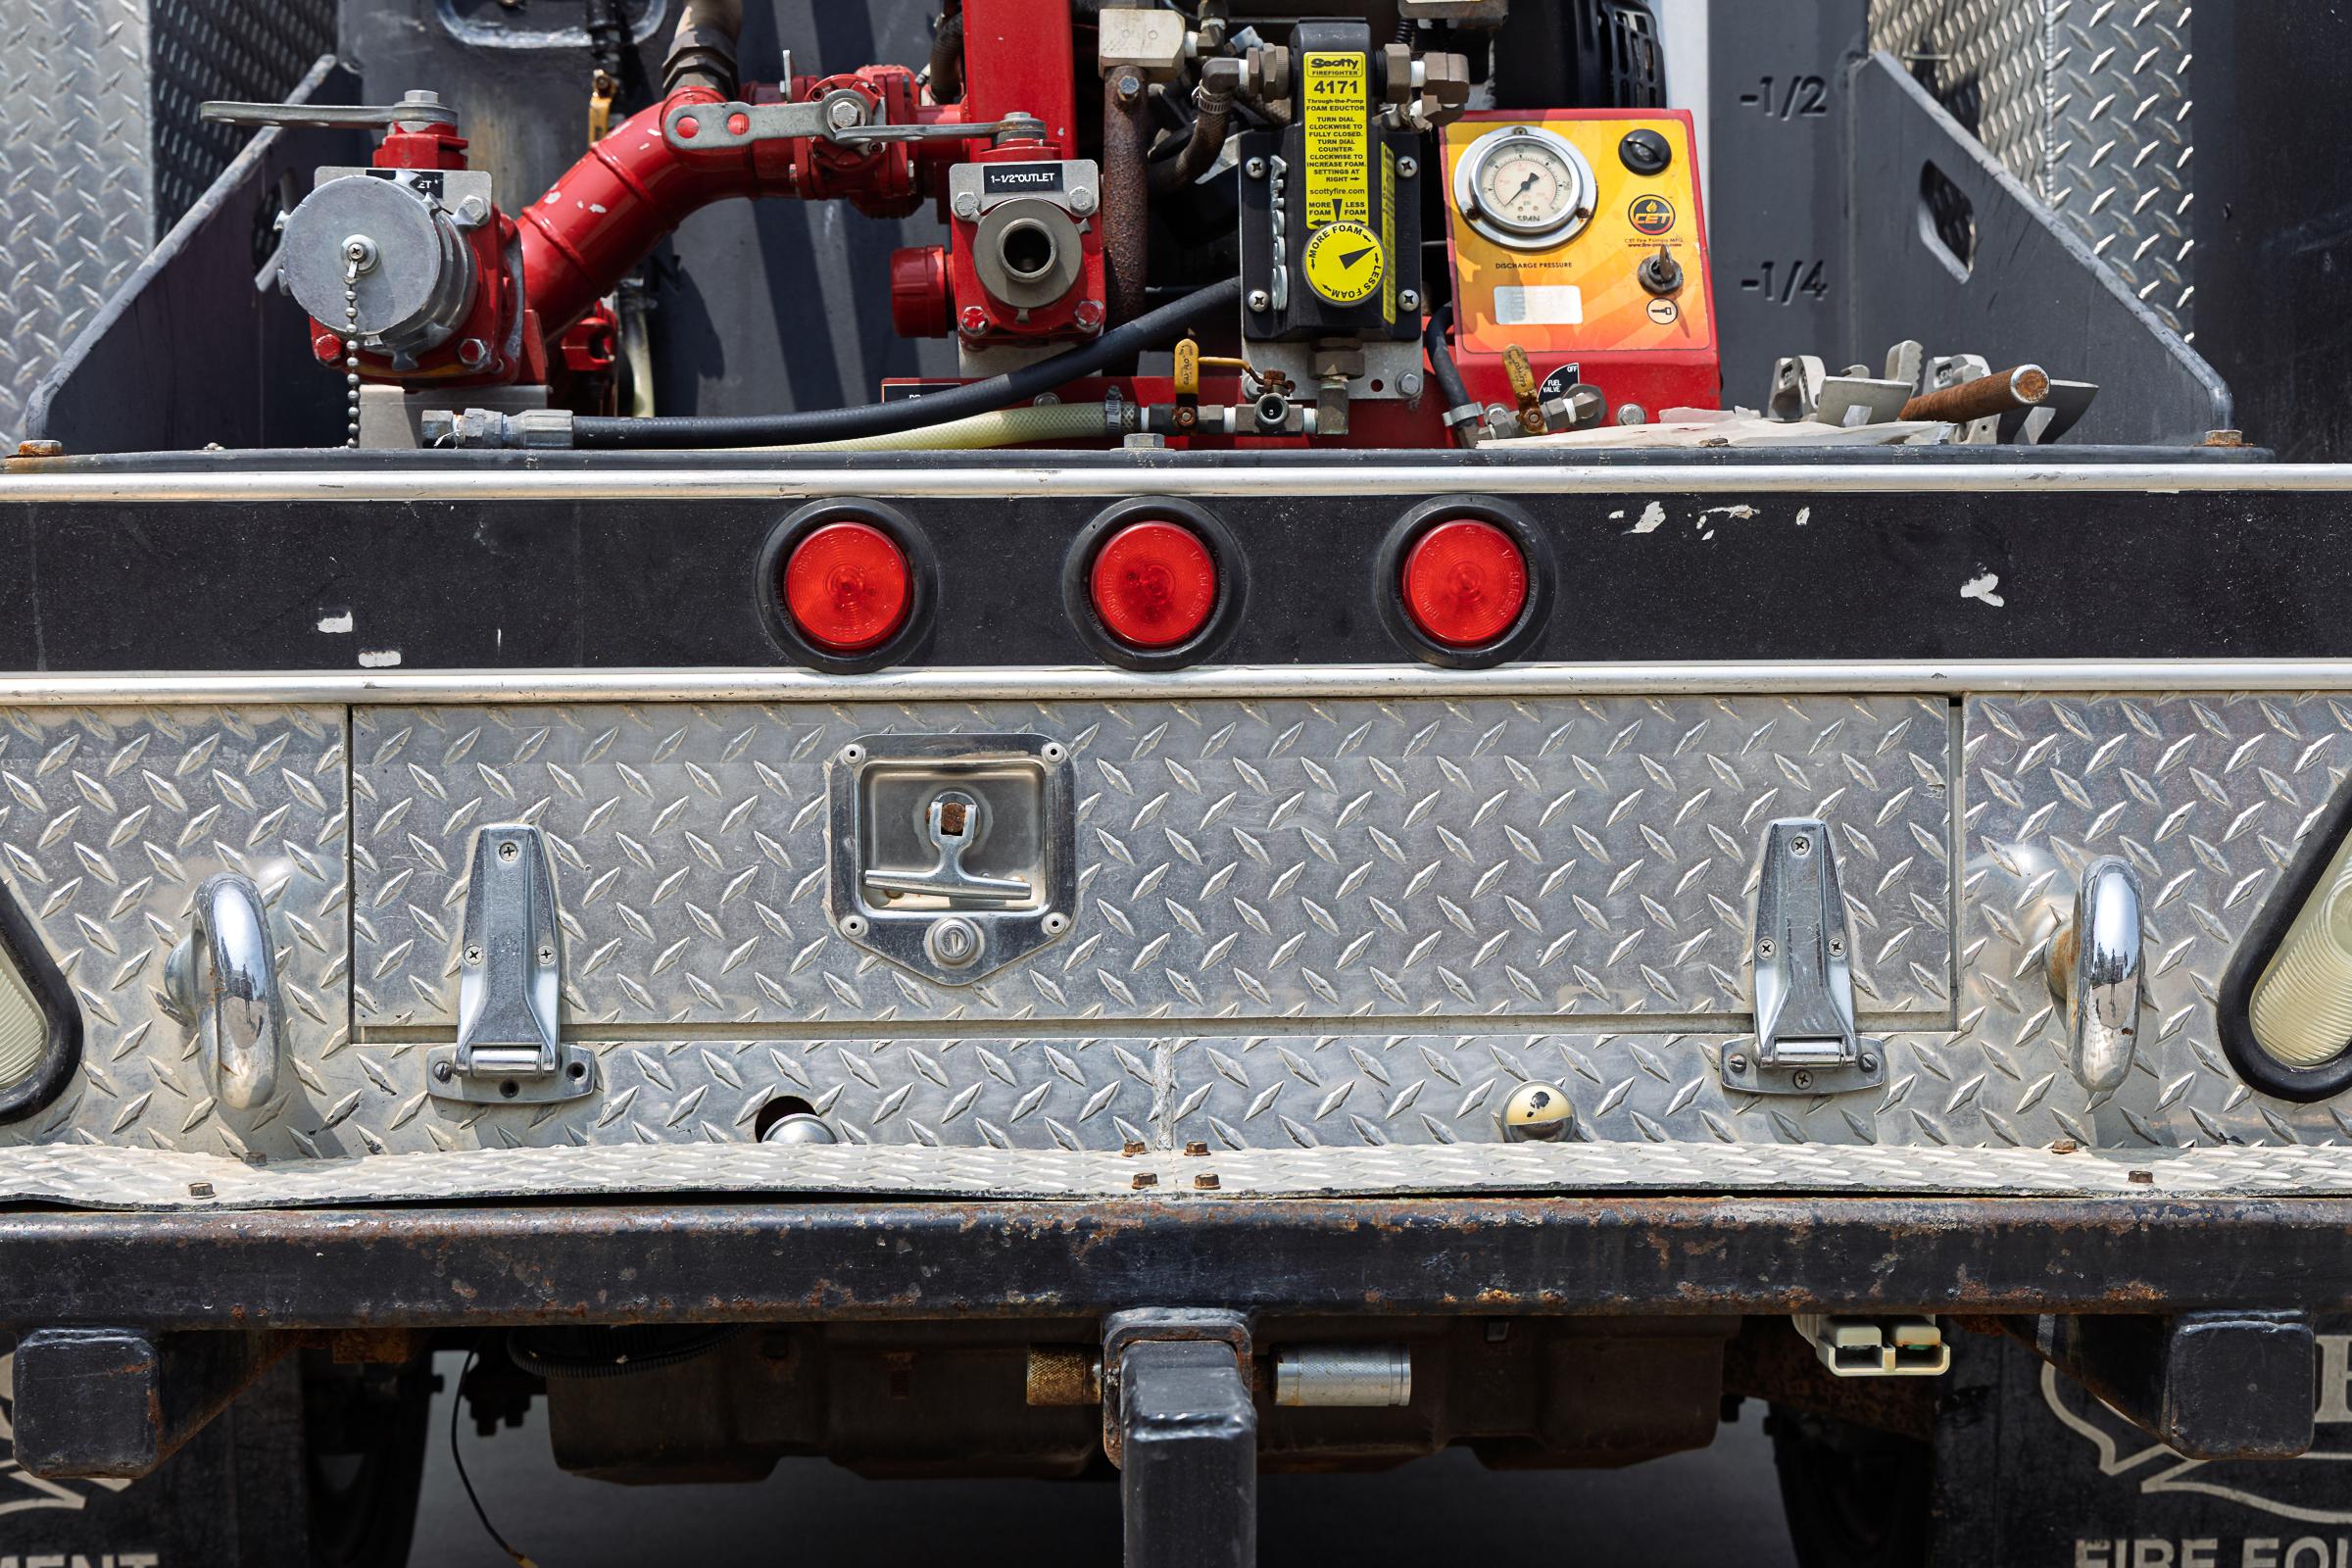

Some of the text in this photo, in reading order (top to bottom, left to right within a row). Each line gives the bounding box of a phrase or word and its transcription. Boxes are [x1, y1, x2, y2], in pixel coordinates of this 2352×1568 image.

[1310, 58, 1359, 70] Scotty
[1313, 80, 1358, 94] 4171
[1309, 187, 1365, 196] scottyfire.com
[1634, 213, 1671, 225] CET
[1308, 224, 1363, 259] MORE FOAM
[1331, 265, 1382, 298] LESS FOAM
